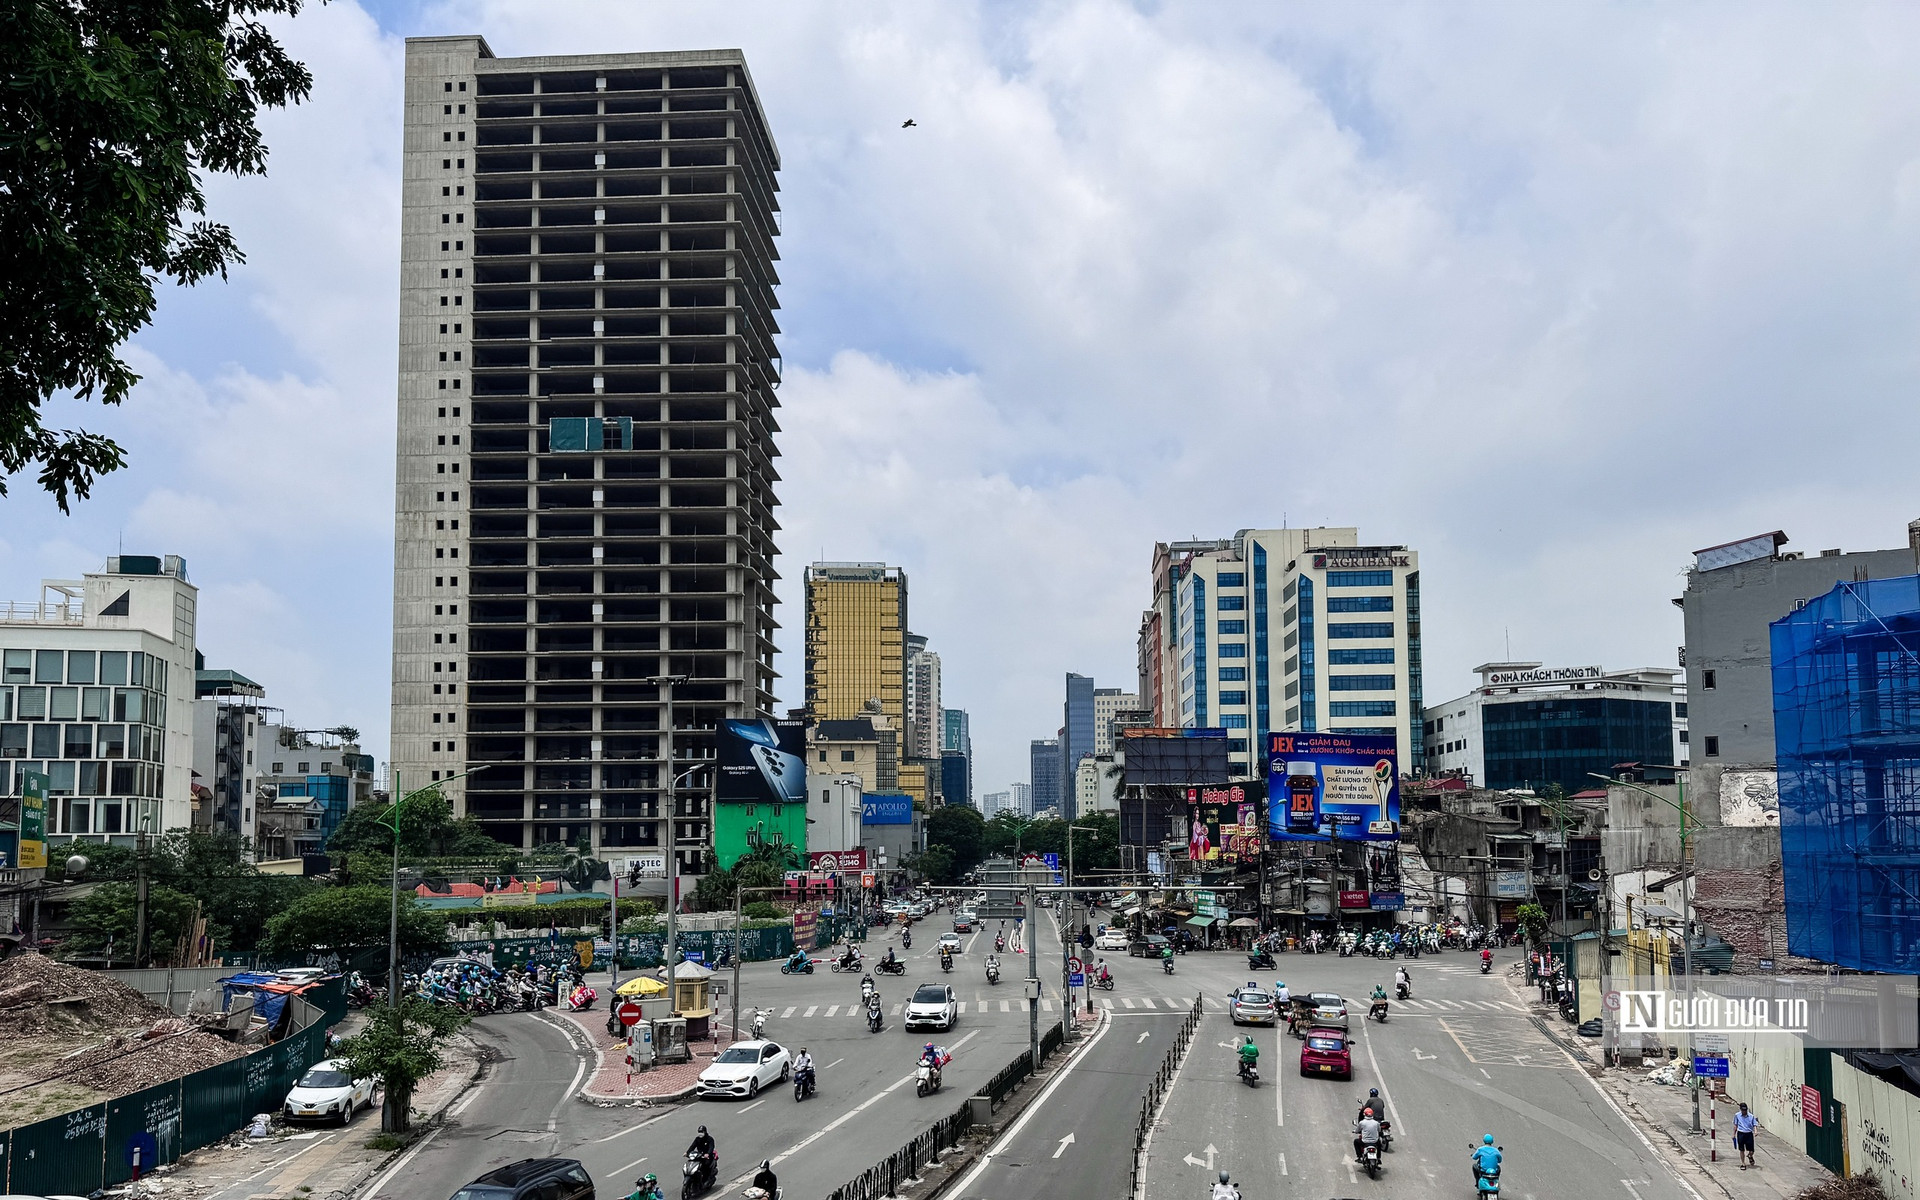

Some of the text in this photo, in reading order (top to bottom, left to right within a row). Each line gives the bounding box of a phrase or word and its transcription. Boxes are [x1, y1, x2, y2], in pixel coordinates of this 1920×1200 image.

[1330, 555, 1410, 567] AGRIBANK
[1500, 672, 1519, 683] NHÀ
[1520, 669, 1551, 681] KHÁCH
[1553, 667, 1583, 679] THÔNG
[1271, 736, 1295, 753] JEX
[1309, 737, 1331, 746] GIẢM
[1333, 739, 1351, 747] ĐAU
[1334, 747, 1355, 755] KHỚP
[1347, 767, 1363, 775] PHẨM
[1326, 775, 1372, 784] CHẤT LƯỢNG TỐT
[1202, 786, 1245, 806] Hoàng Gia
[1357, 792, 1374, 800] DÙNG
[878, 803, 907, 811] APOLLO
[1290, 794, 1314, 811] JEX
